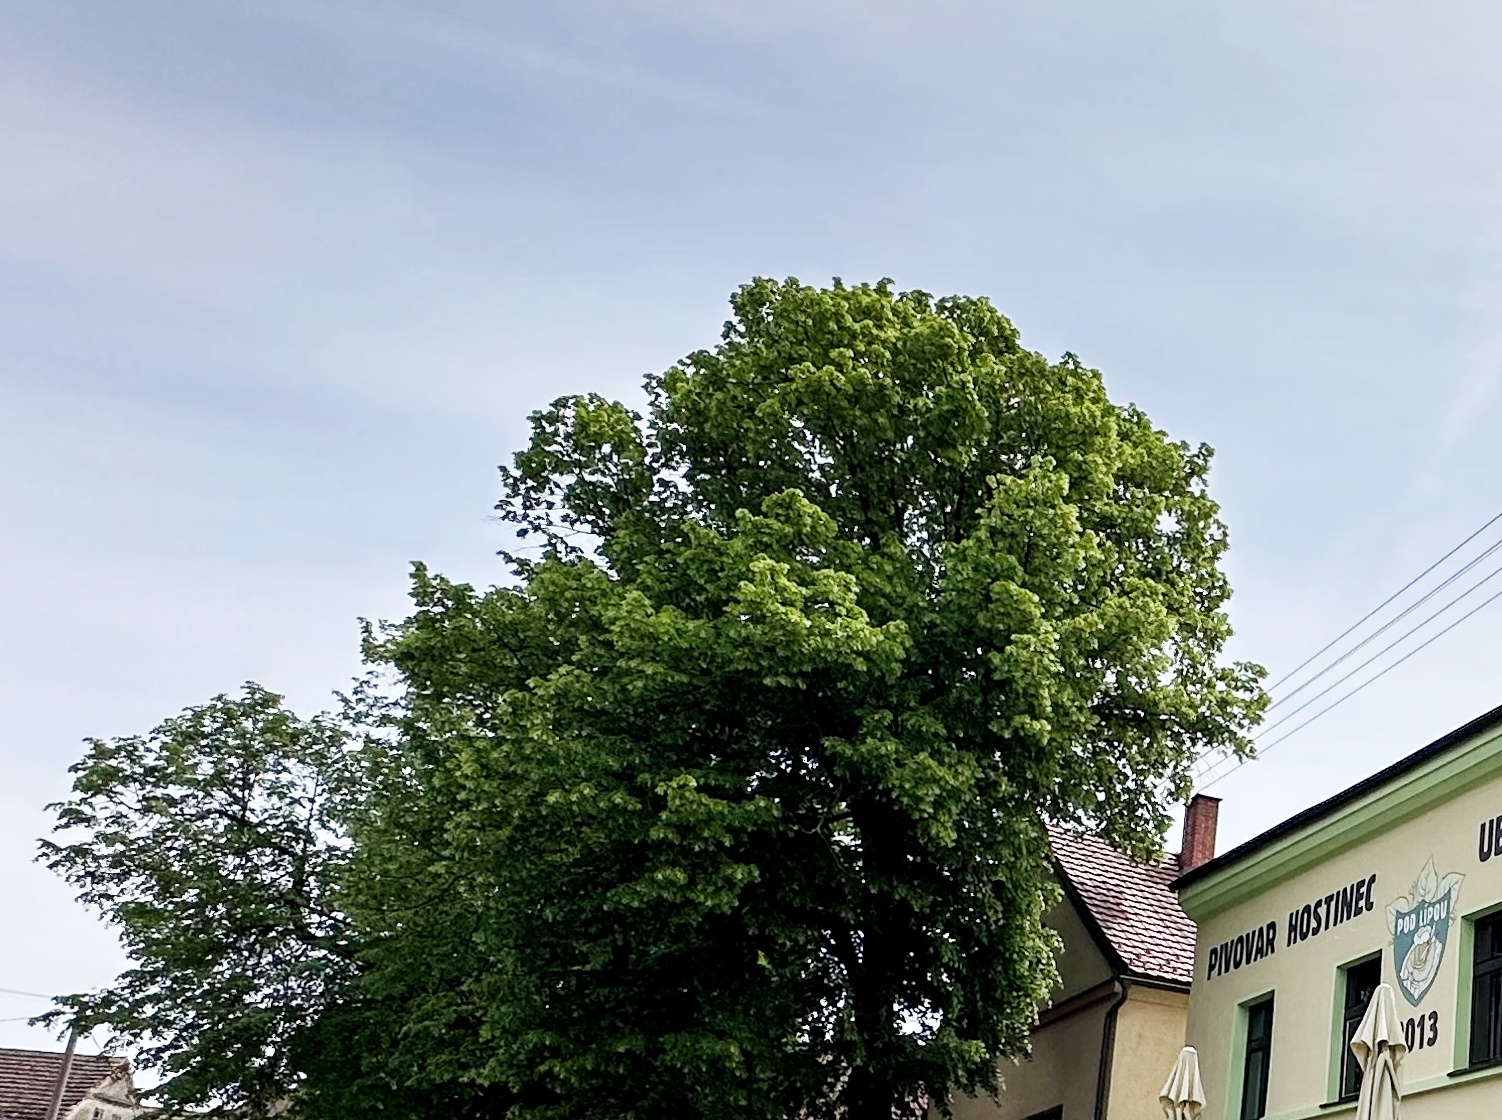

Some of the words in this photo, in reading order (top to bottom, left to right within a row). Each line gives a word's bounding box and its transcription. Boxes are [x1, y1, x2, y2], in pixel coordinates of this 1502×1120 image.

[1206, 920, 1277, 981] PIVOVAR
[1286, 873, 1377, 948] HOSTINEC
[1397, 915, 1416, 936] POD
[1419, 900, 1447, 927] LÍPOU
[1400, 1010, 1438, 1053] 013
